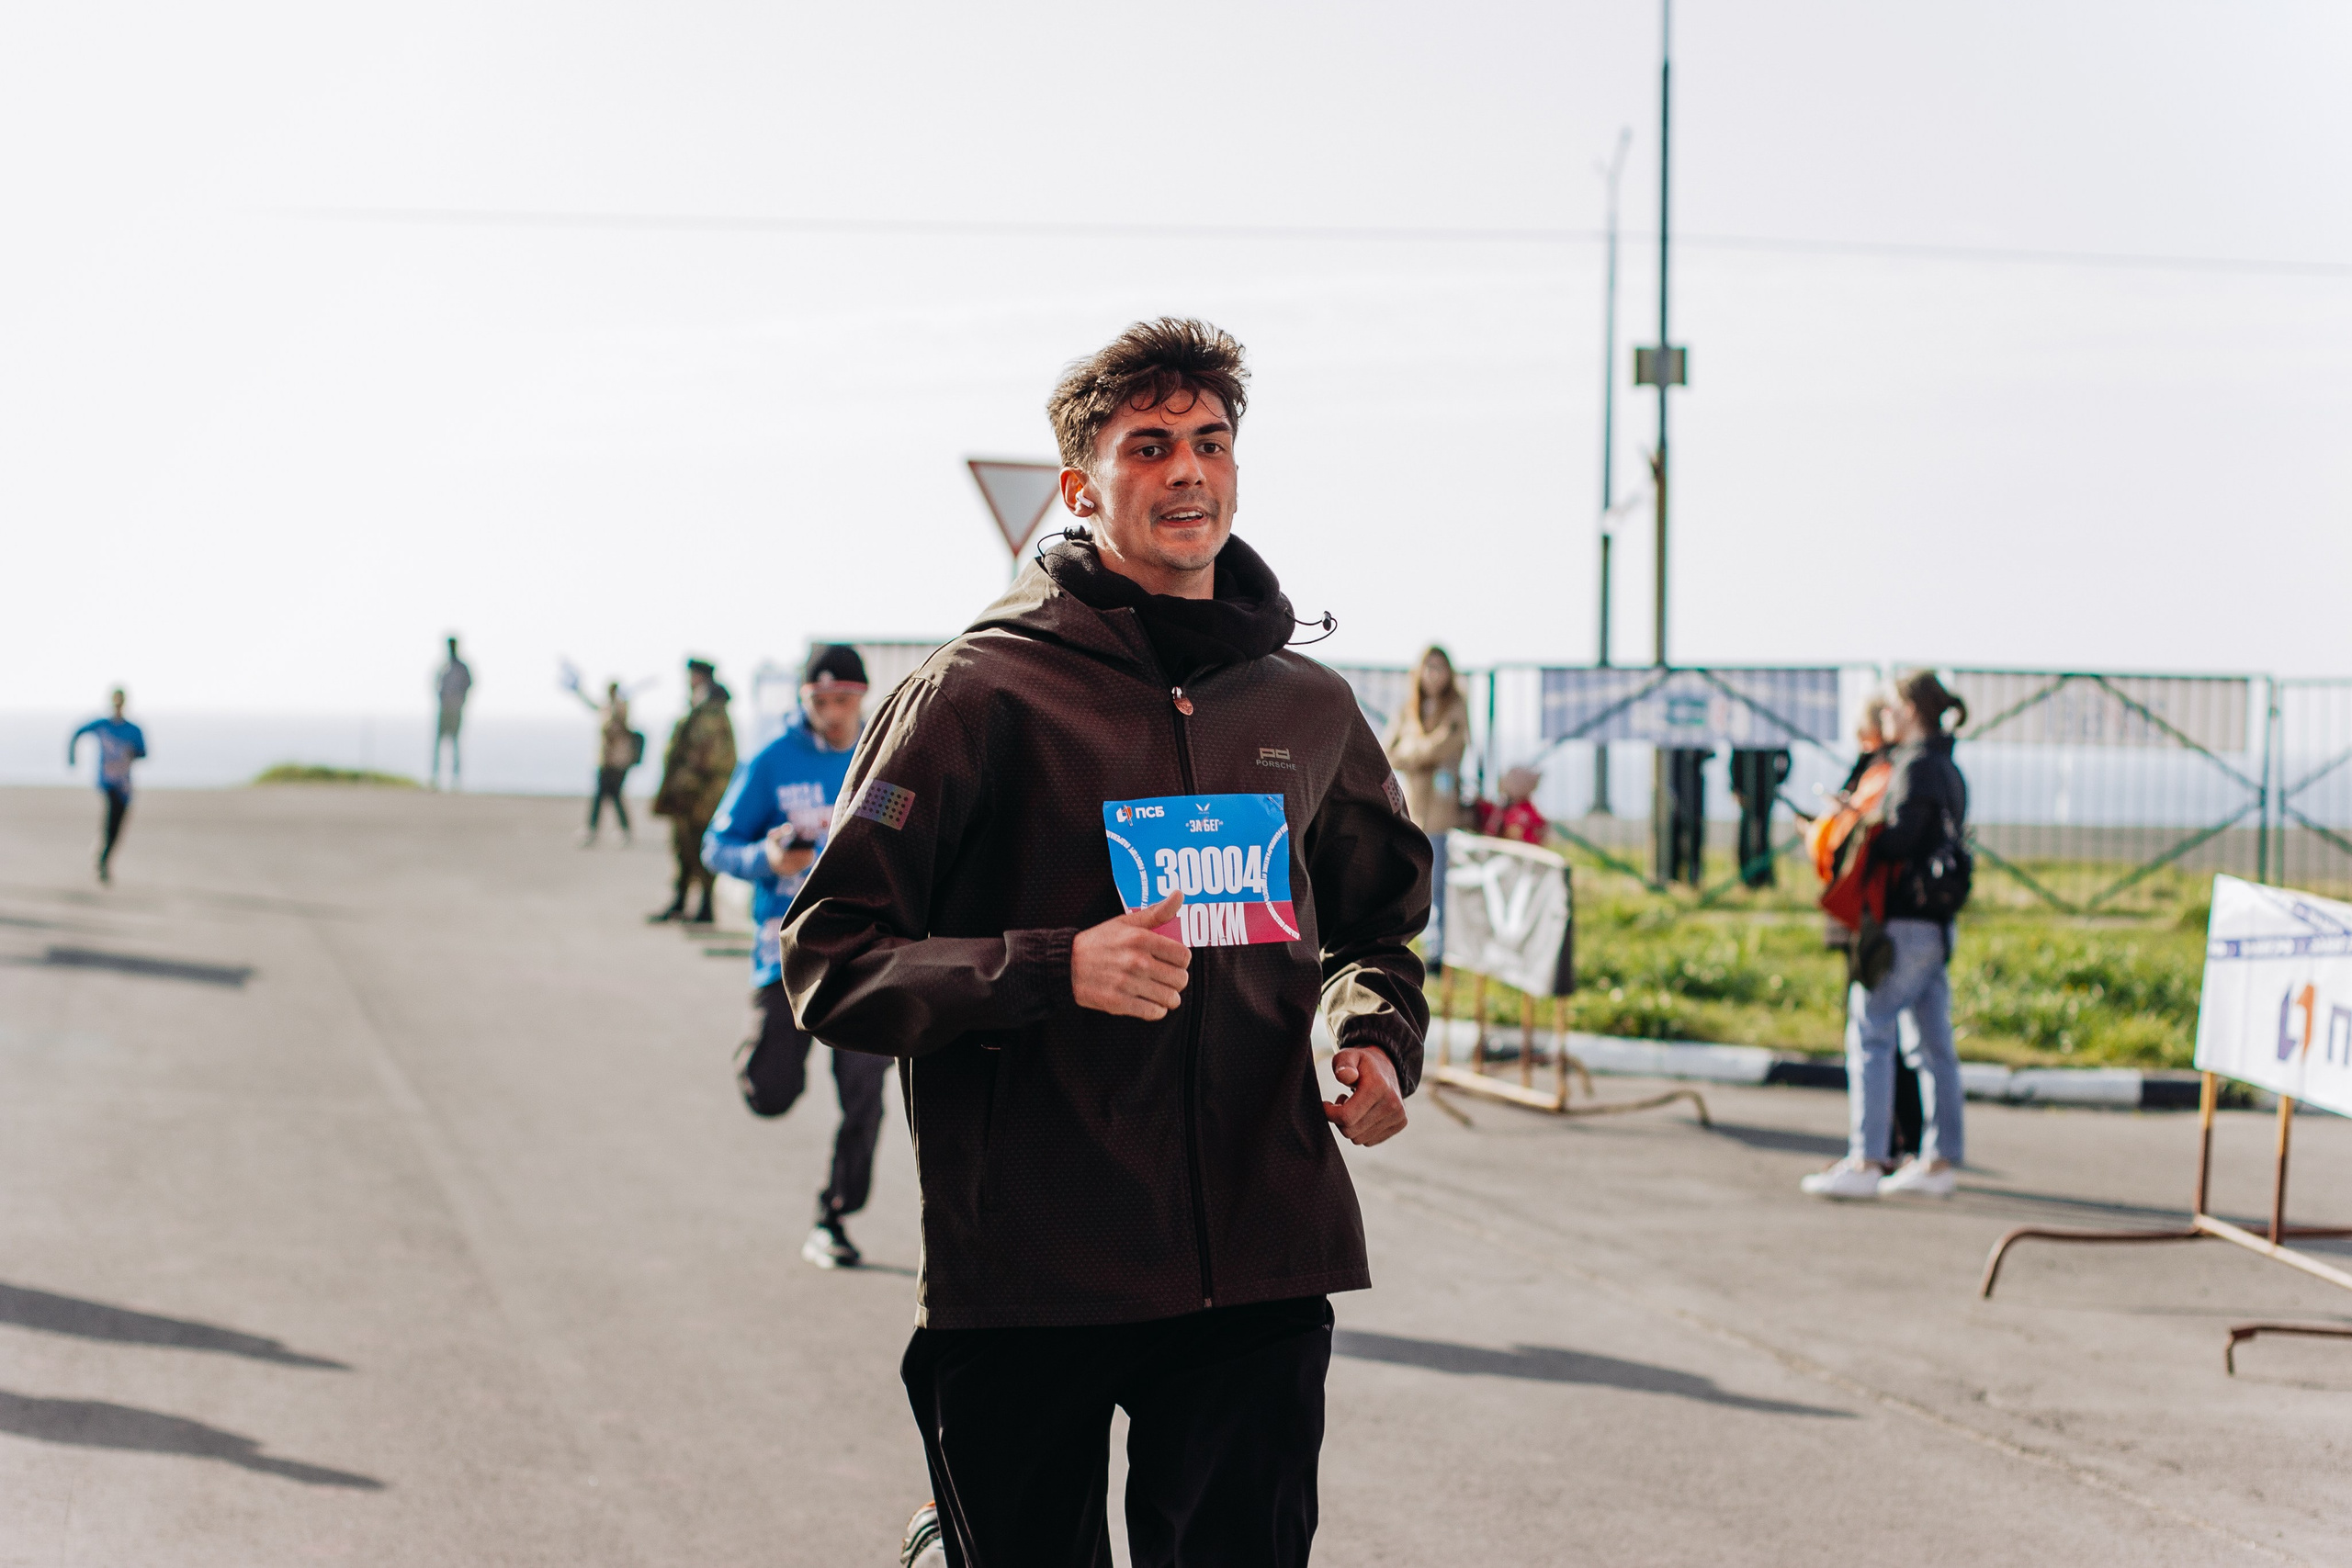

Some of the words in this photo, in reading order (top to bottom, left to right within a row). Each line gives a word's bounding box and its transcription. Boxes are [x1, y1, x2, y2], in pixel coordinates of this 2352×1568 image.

[1256, 759, 1297, 771] PORSCHE
[1135, 806, 1165, 819] ПСБ
[1154, 845, 1263, 897] 30004
